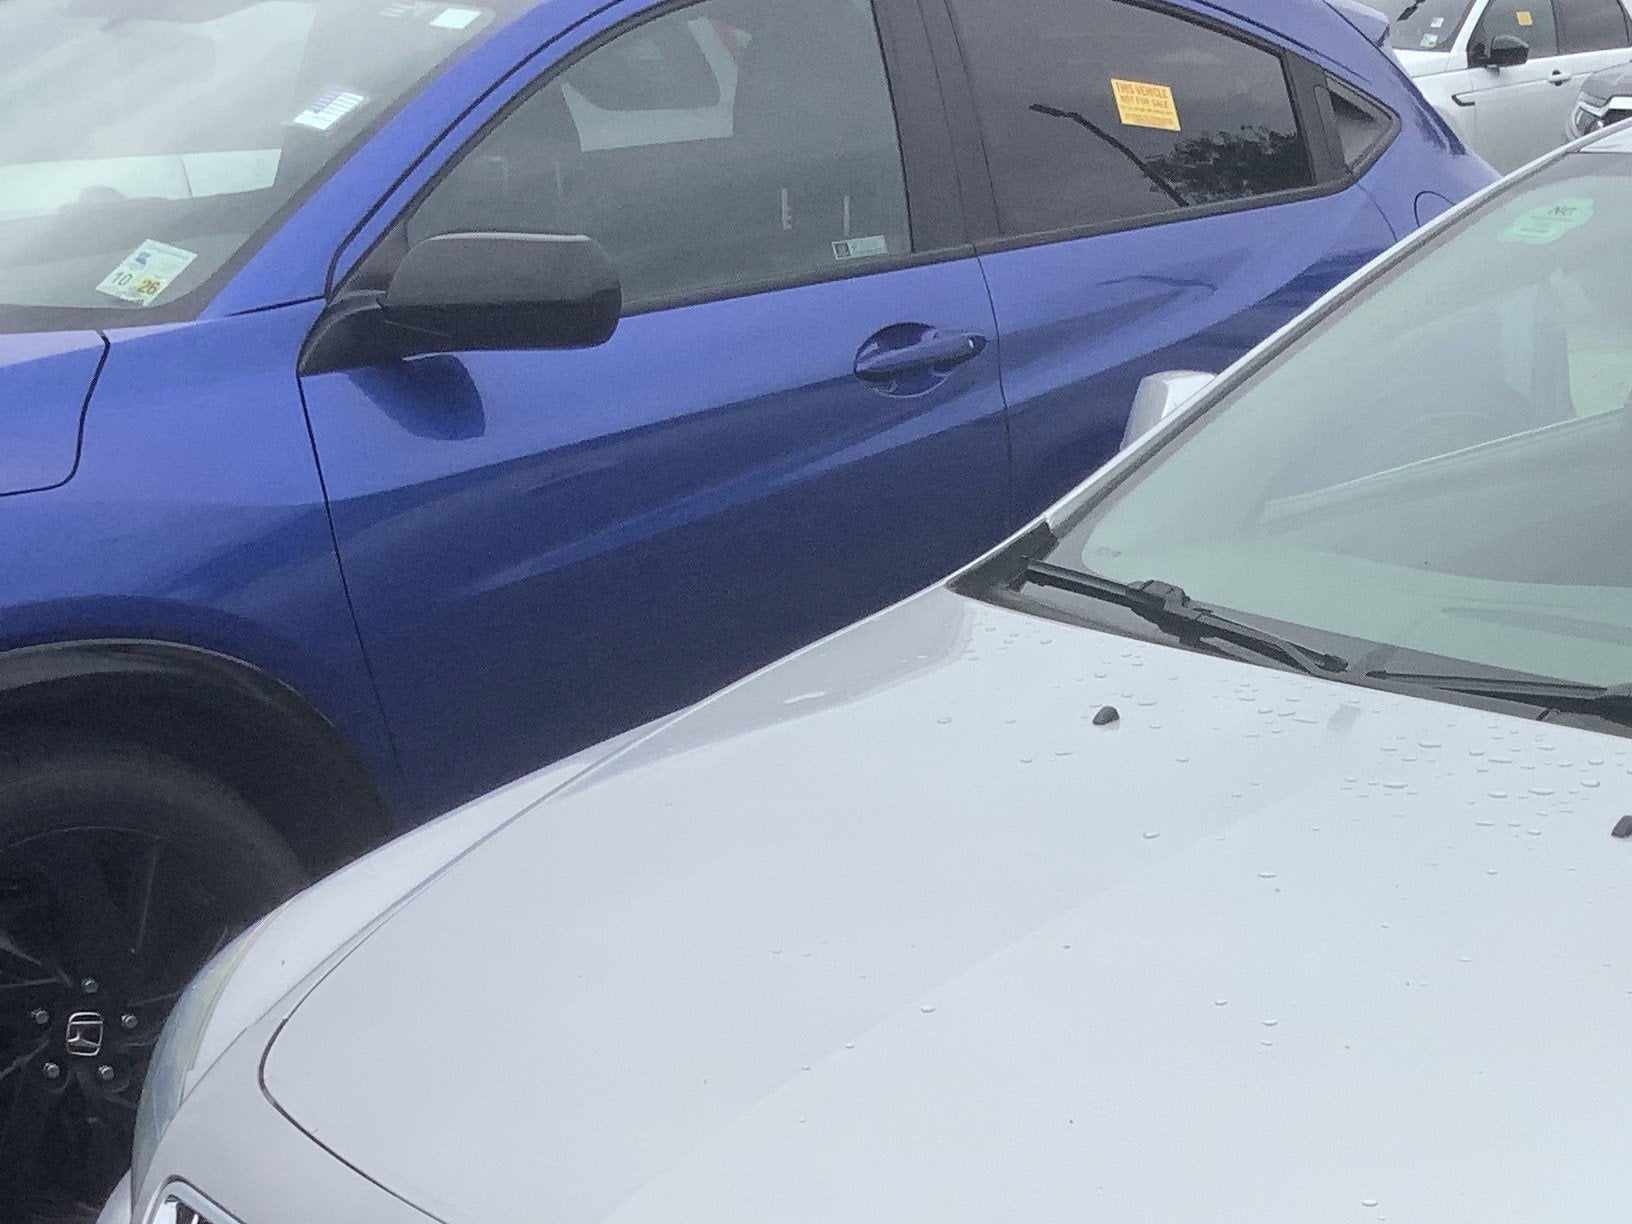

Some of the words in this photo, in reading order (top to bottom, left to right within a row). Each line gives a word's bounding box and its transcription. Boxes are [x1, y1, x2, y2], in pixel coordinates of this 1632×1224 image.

[1134, 86, 1169, 98] VEHICLE
[112, 272, 132, 286] 10
[136, 280, 160, 294] 26
